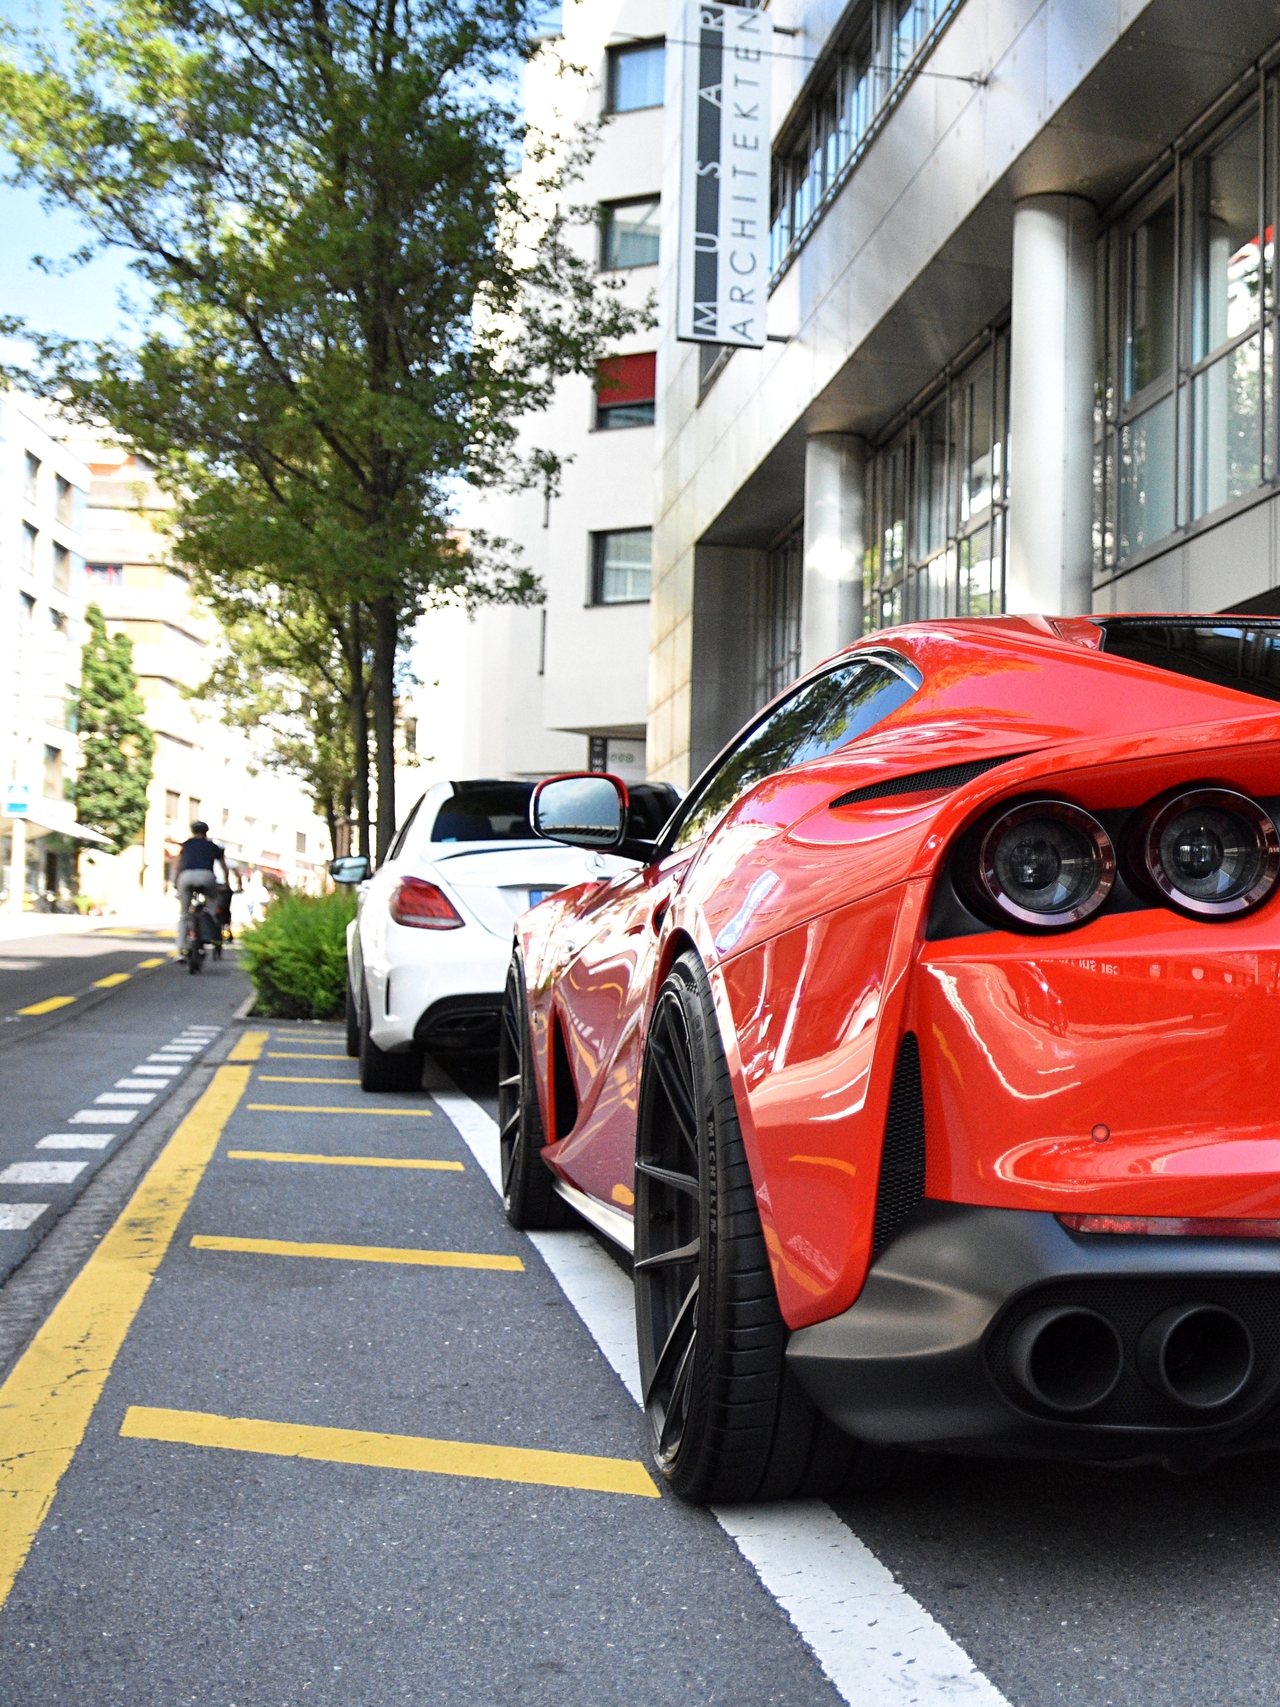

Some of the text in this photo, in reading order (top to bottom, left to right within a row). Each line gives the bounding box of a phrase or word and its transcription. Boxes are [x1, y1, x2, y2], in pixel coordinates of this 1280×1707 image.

[693, 7, 724, 336] MUSAR
[730, 9, 761, 341] ARCHITEKTEN
[707, 1121, 718, 1234] MICHELIN
